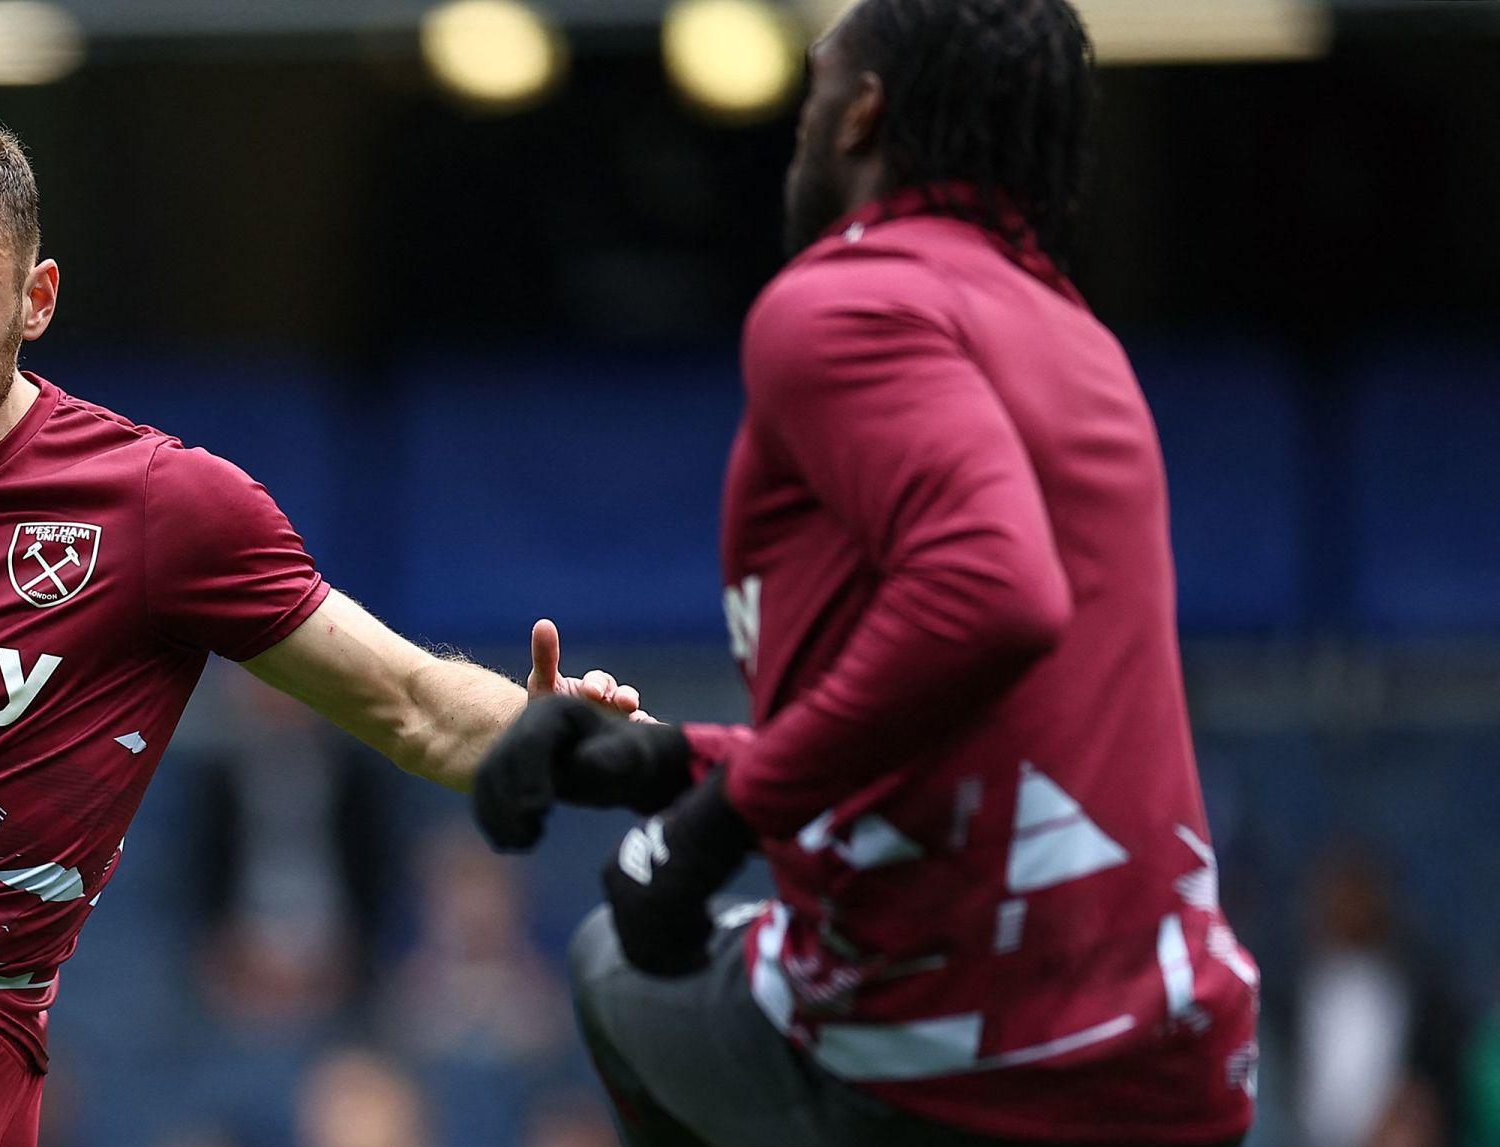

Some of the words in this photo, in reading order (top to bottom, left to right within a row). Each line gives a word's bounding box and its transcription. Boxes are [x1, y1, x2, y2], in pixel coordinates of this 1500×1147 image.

[25, 526, 59, 535] WEST
[59, 527, 90, 540] HAM
[36, 533, 75, 544] UNITED
[27, 589, 58, 600] LONDON
